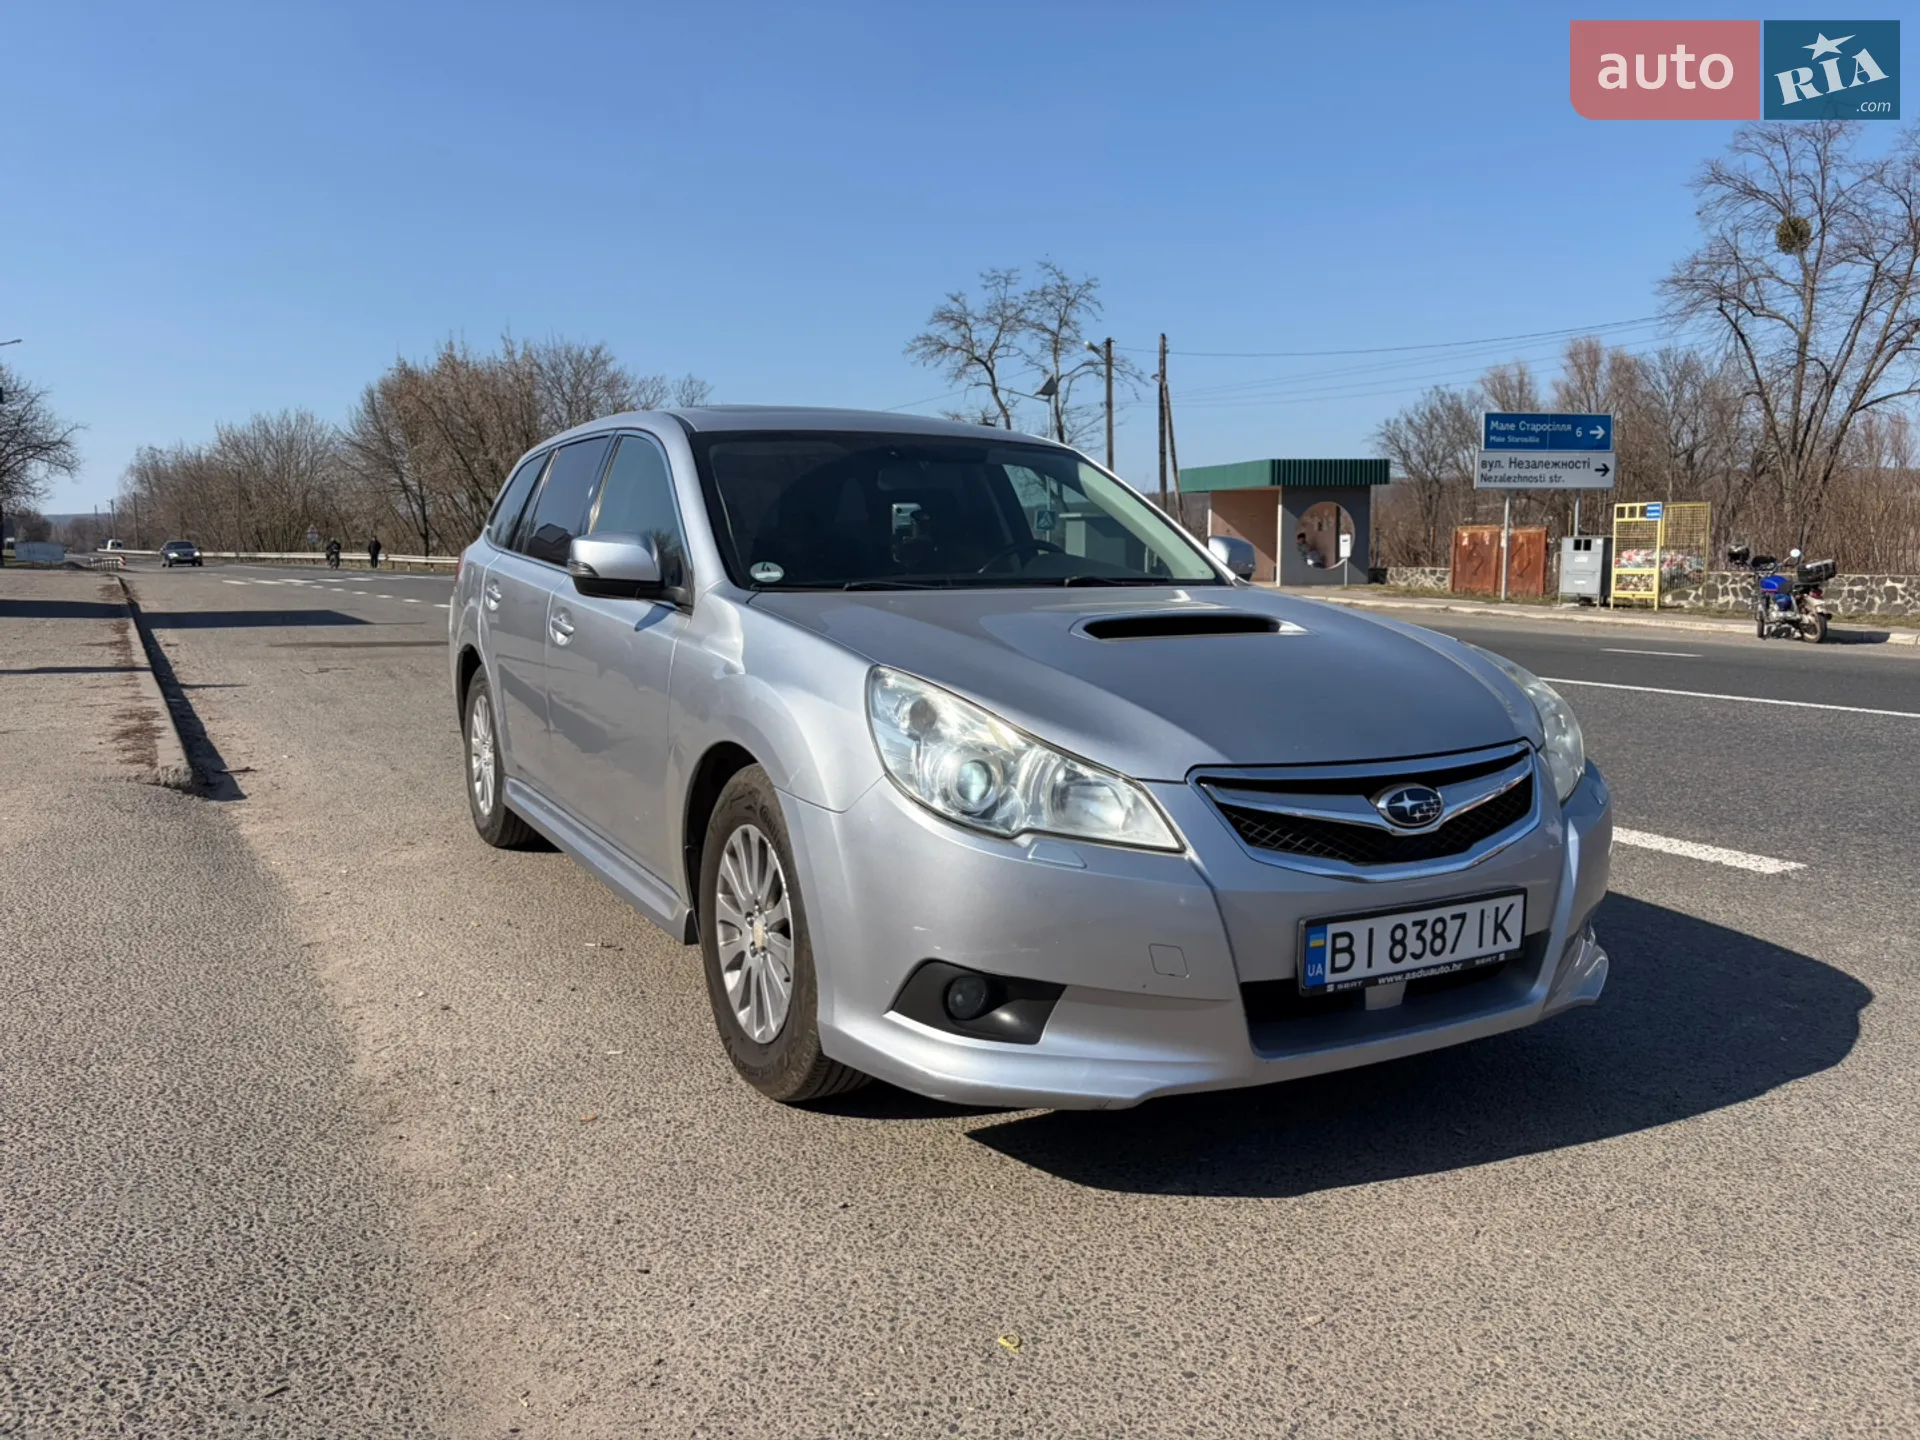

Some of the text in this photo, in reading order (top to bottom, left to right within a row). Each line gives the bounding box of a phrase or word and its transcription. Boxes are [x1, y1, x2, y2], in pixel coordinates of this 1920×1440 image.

[1489, 420, 1572, 433] Мале Старосілля
[1575, 426, 1583, 437] 6
[1481, 457, 1591, 472] вул. Незалежності
[1480, 473, 1565, 483] Nezalezhnosti str.
[1329, 902, 1515, 975] BI 8387 IK
[1307, 963, 1324, 977] UA
